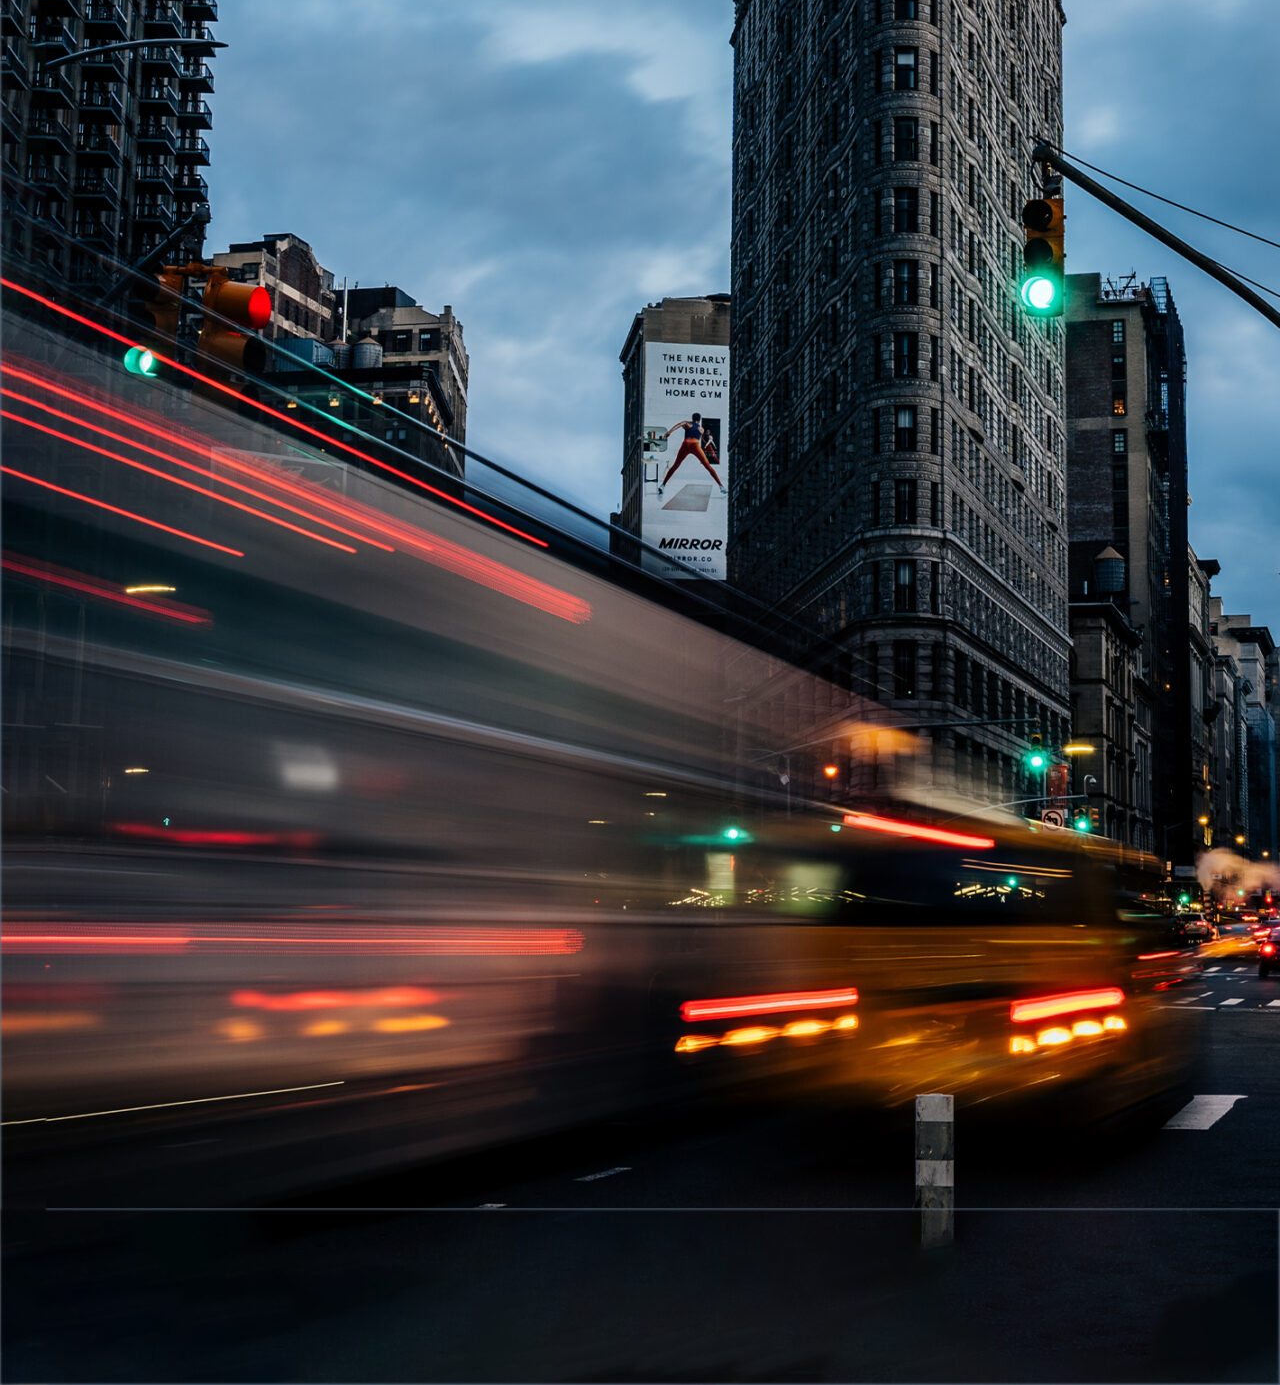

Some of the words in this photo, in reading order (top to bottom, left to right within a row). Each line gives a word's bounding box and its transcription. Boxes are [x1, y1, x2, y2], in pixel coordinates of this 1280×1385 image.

[662, 354, 682, 362] THE
[687, 355, 726, 363] NEARLY
[659, 377, 728, 387] INTERACTIVE
[665, 389, 695, 397] HOME
[658, 537, 722, 550] MIRROR
